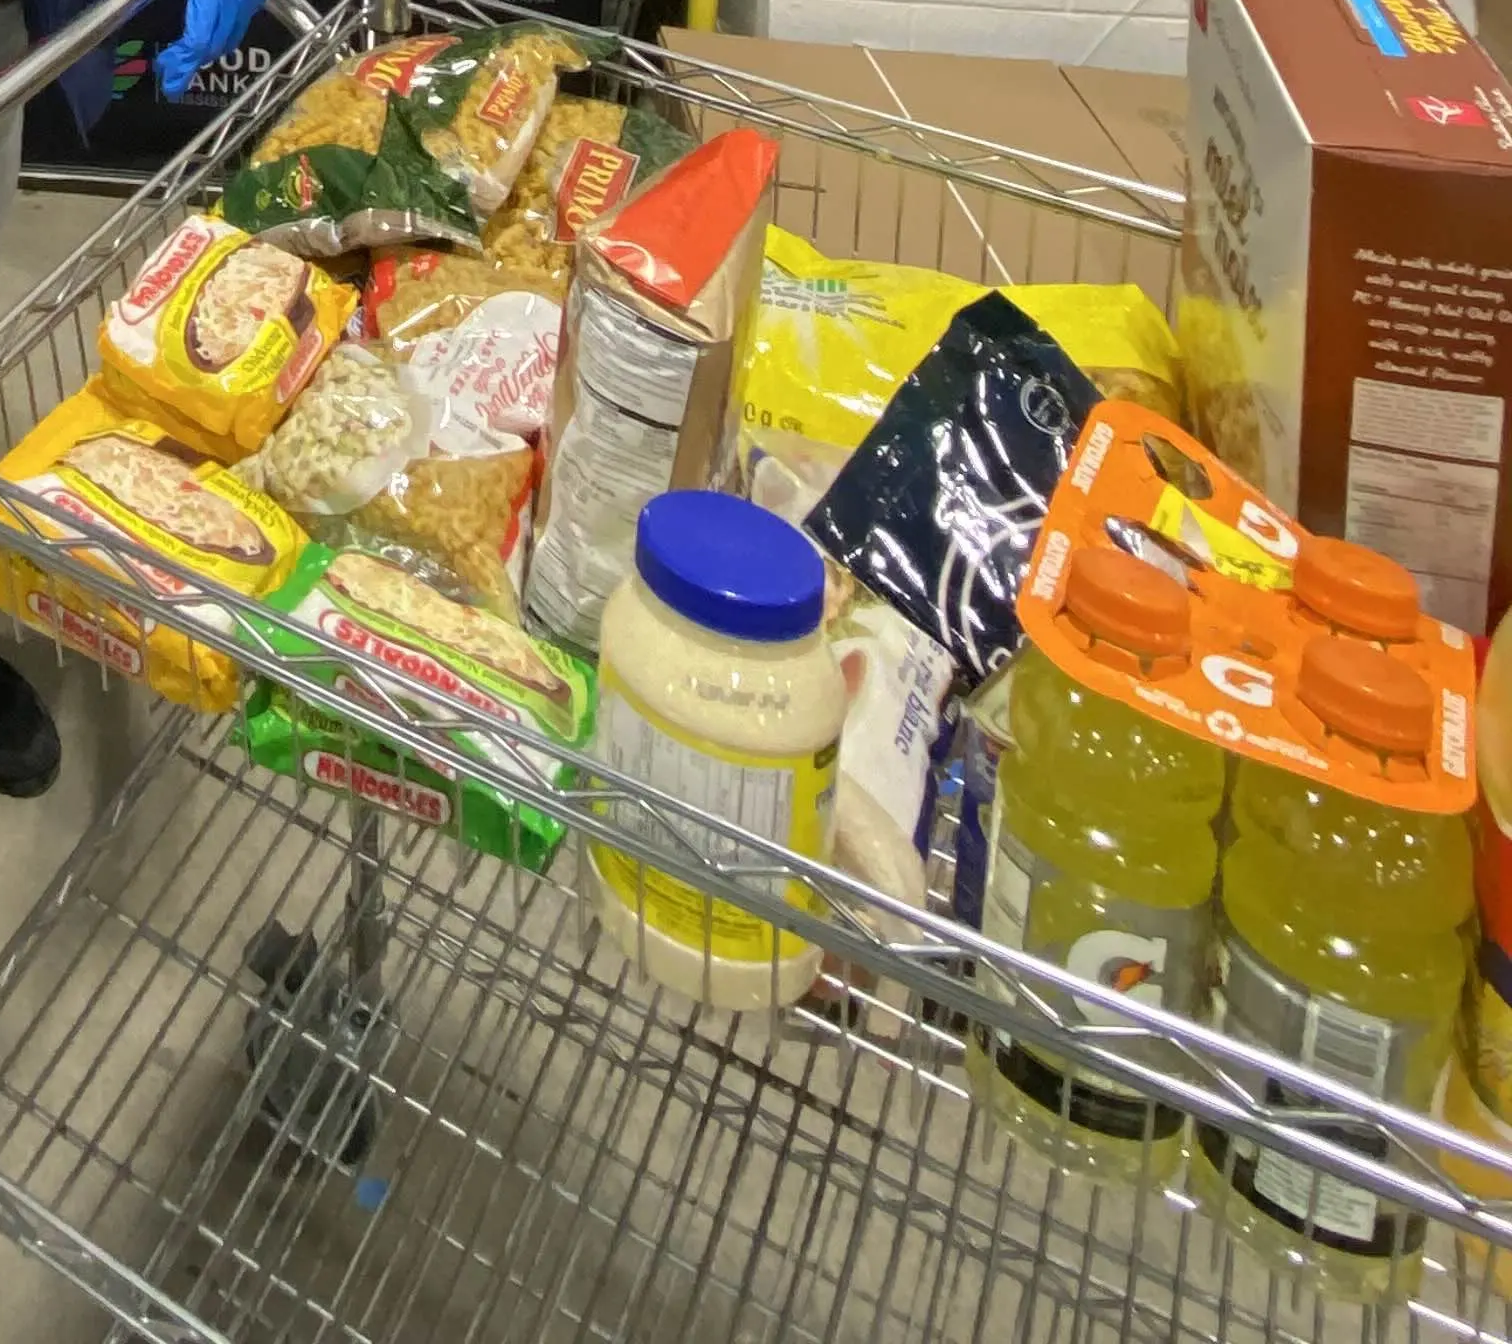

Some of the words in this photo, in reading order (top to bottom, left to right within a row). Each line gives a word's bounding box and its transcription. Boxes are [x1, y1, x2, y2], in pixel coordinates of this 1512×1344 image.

[188, 72, 252, 94] ANK
[486, 74, 524, 118] PRIMO
[565, 148, 624, 232] PRIMO
[1201, 654, 1275, 708] G
